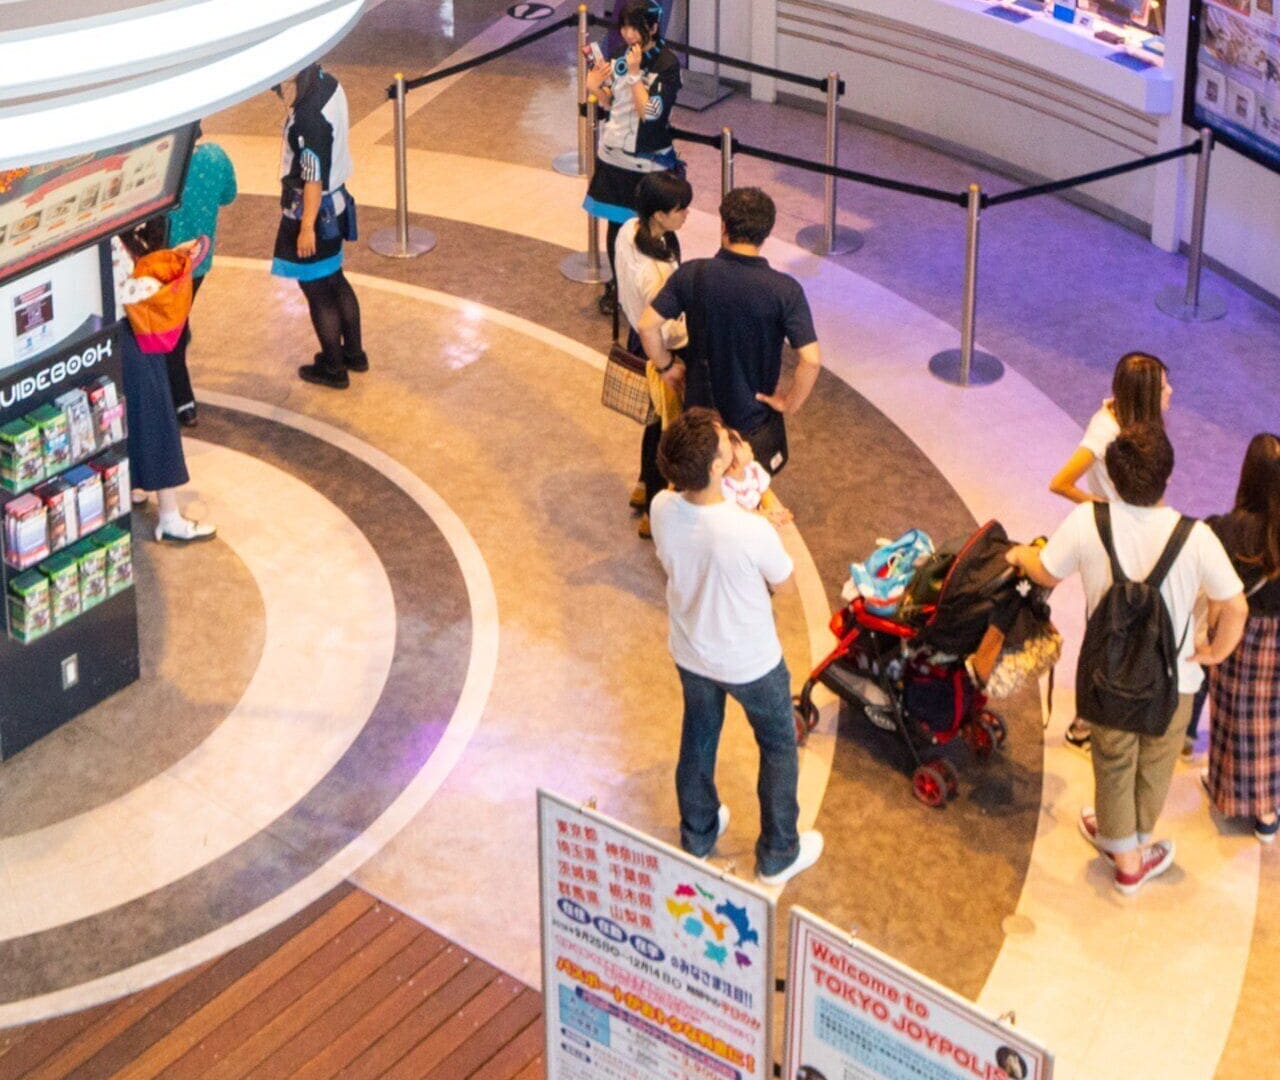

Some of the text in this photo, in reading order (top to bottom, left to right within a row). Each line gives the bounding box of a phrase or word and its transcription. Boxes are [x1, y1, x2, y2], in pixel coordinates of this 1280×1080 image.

[557, 818, 598, 842] 東京都
[557, 839, 598, 862] 埼玉県
[604, 841, 660, 873] 神奈川県
[558, 859, 599, 884] 茨城県
[609, 863, 653, 888] 千葉県
[558, 880, 600, 906] 群馬県
[609, 882, 653, 910] 栃木県
[610, 904, 653, 931] 山梨県
[810, 939, 901, 1004] Welcome
[903, 991, 930, 1020] to
[811, 965, 890, 1022] TOKYO
